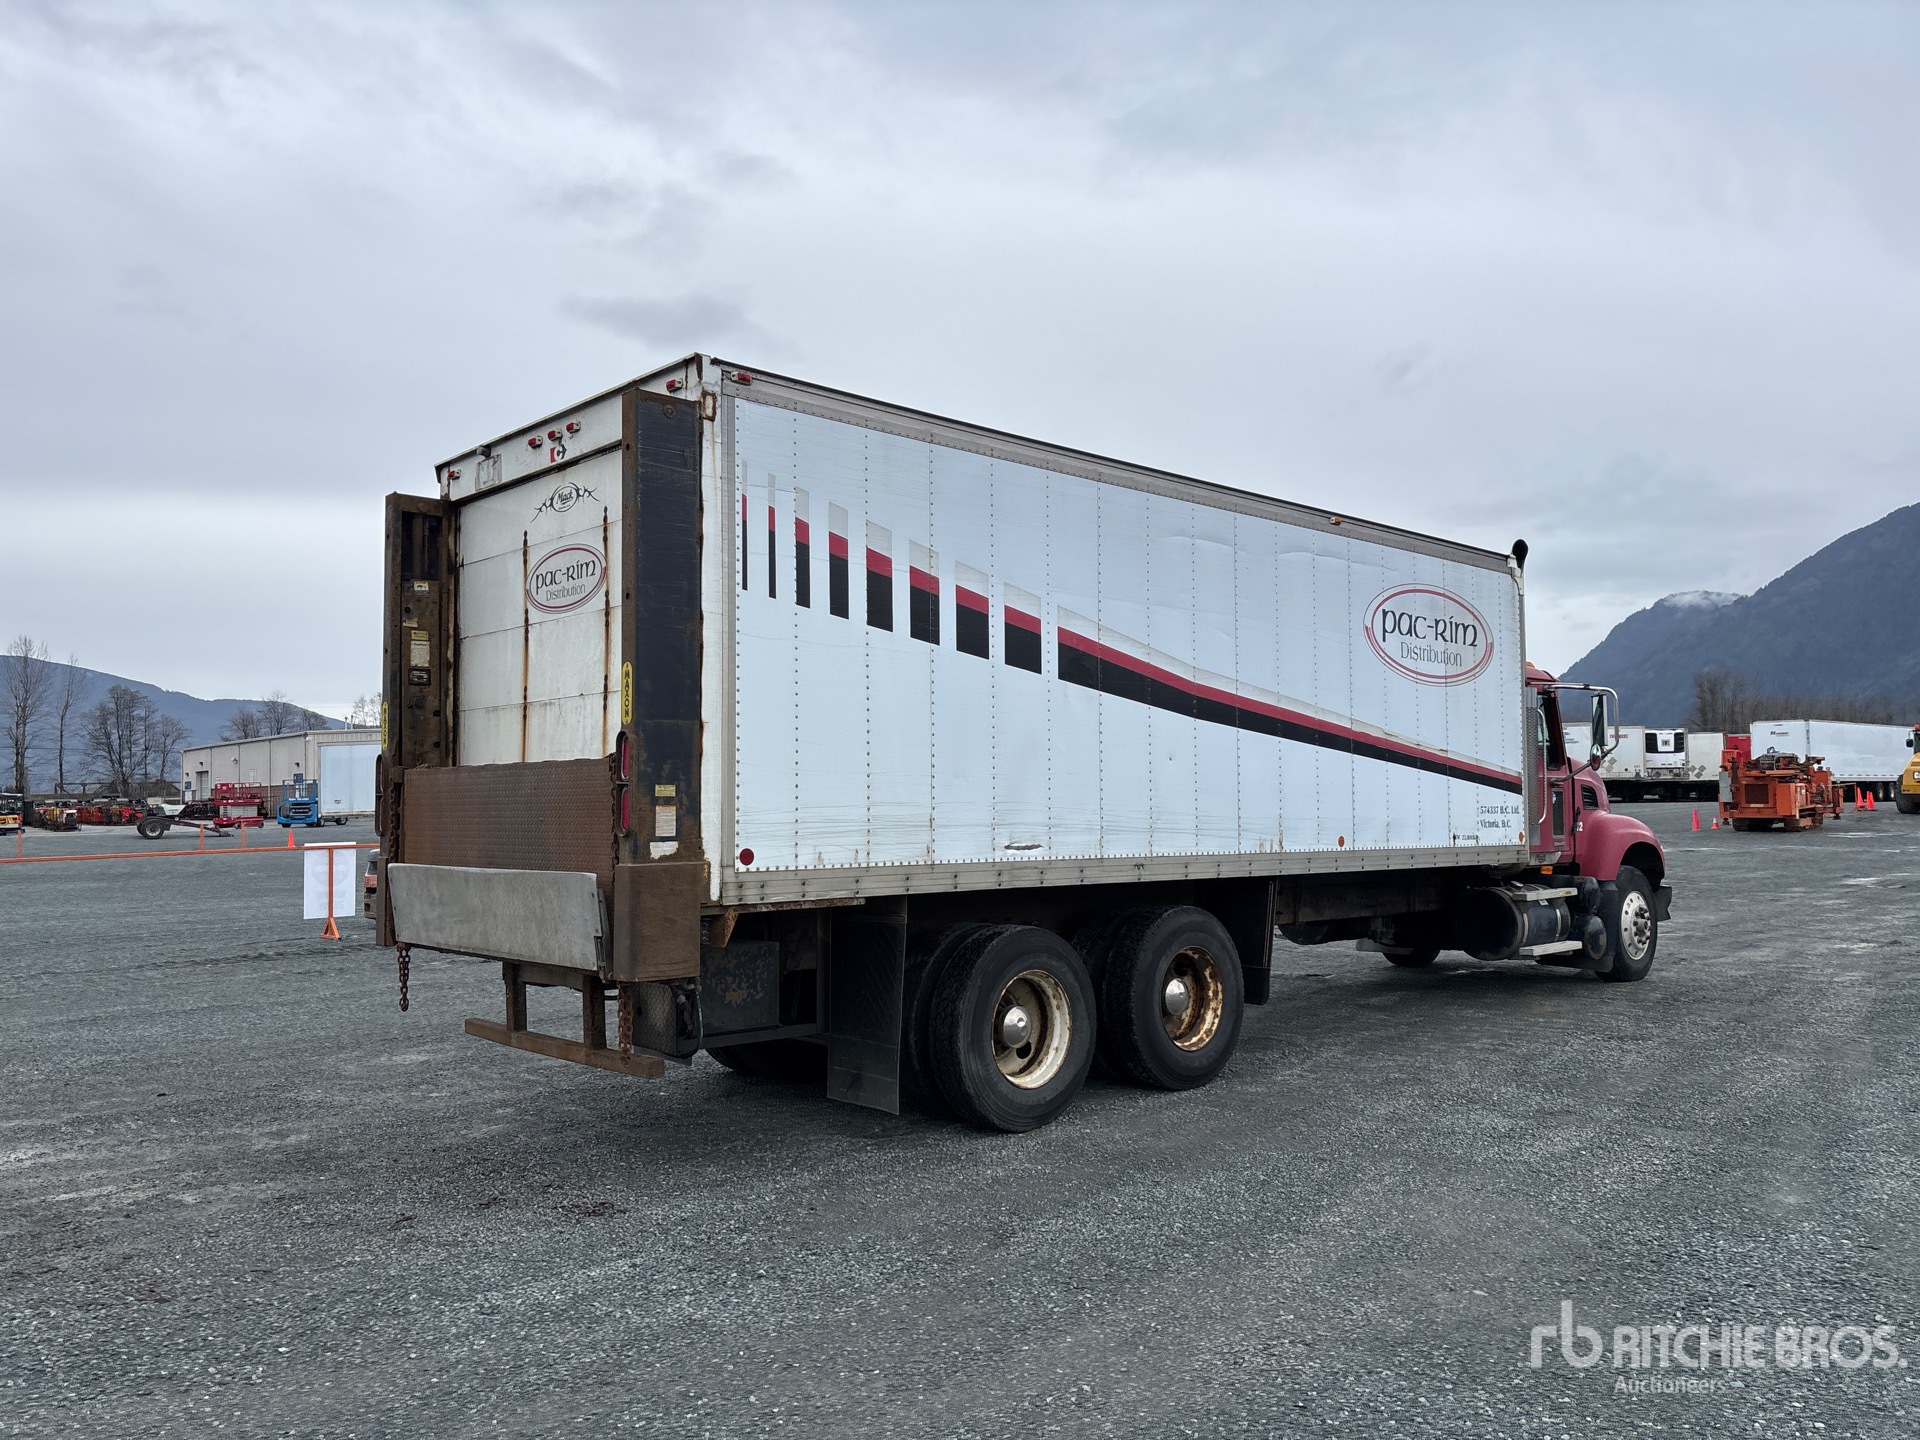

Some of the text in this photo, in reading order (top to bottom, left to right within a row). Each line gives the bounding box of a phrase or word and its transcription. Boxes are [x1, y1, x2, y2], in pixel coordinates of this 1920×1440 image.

[545, 583, 586, 601] Distribution
[1400, 641, 1463, 667] Distribution
[1500, 805, 1510, 814] B.C.
[1480, 819, 1511, 829] Victoria, B.C.
